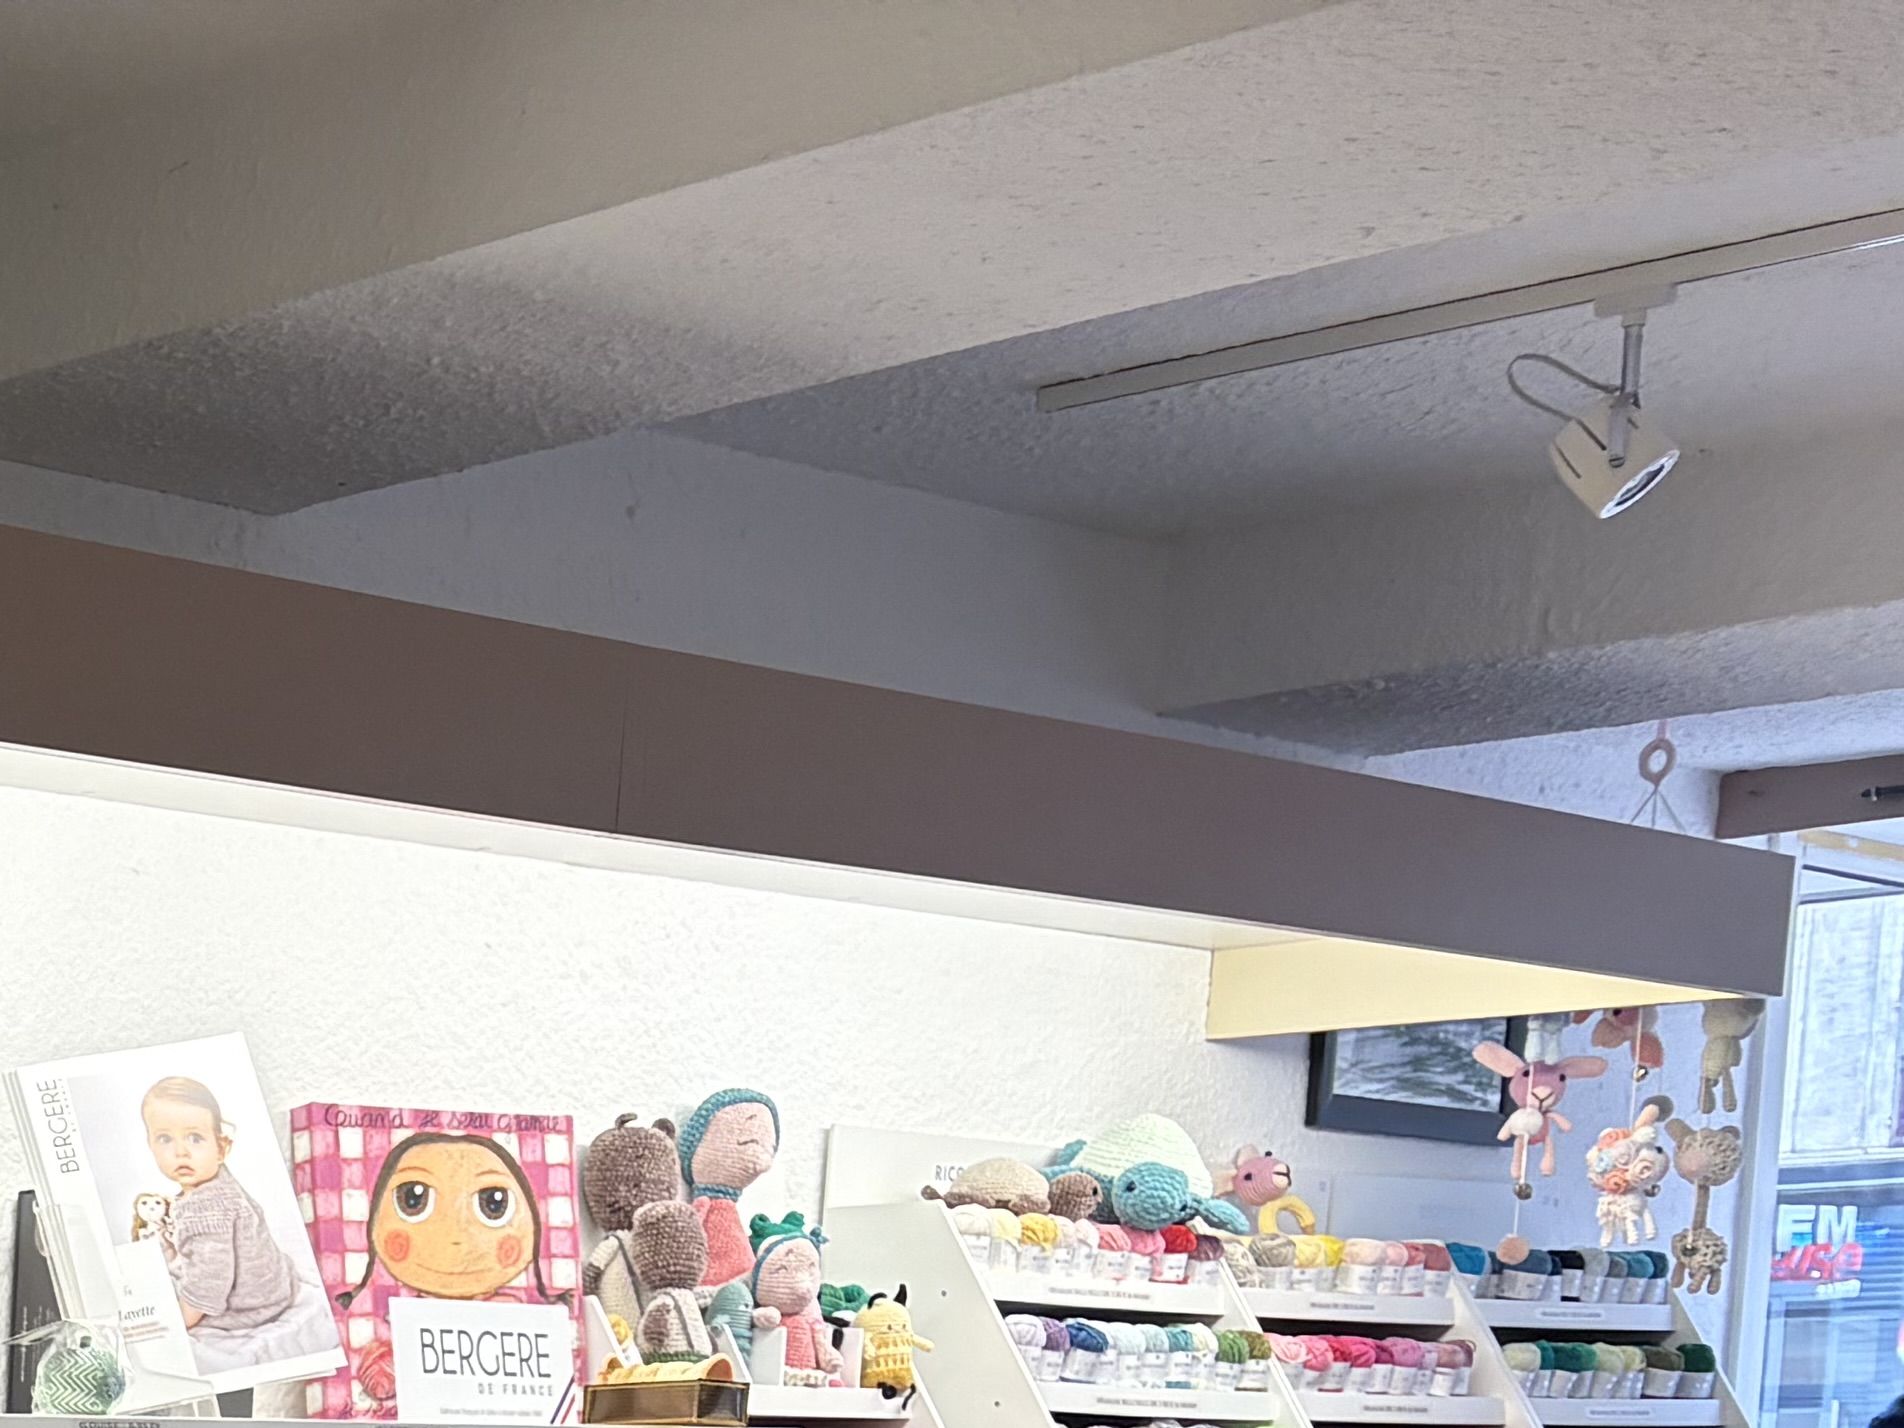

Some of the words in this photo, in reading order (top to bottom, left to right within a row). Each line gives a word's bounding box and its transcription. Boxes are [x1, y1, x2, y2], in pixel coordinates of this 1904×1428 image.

[37, 1078, 80, 1173] BERGERE
[324, 1104, 408, 1128] Quand
[419, 1328, 551, 1378] BERGERE
[478, 1382, 494, 1395] DE
[502, 1383, 554, 1397] FRANCE
